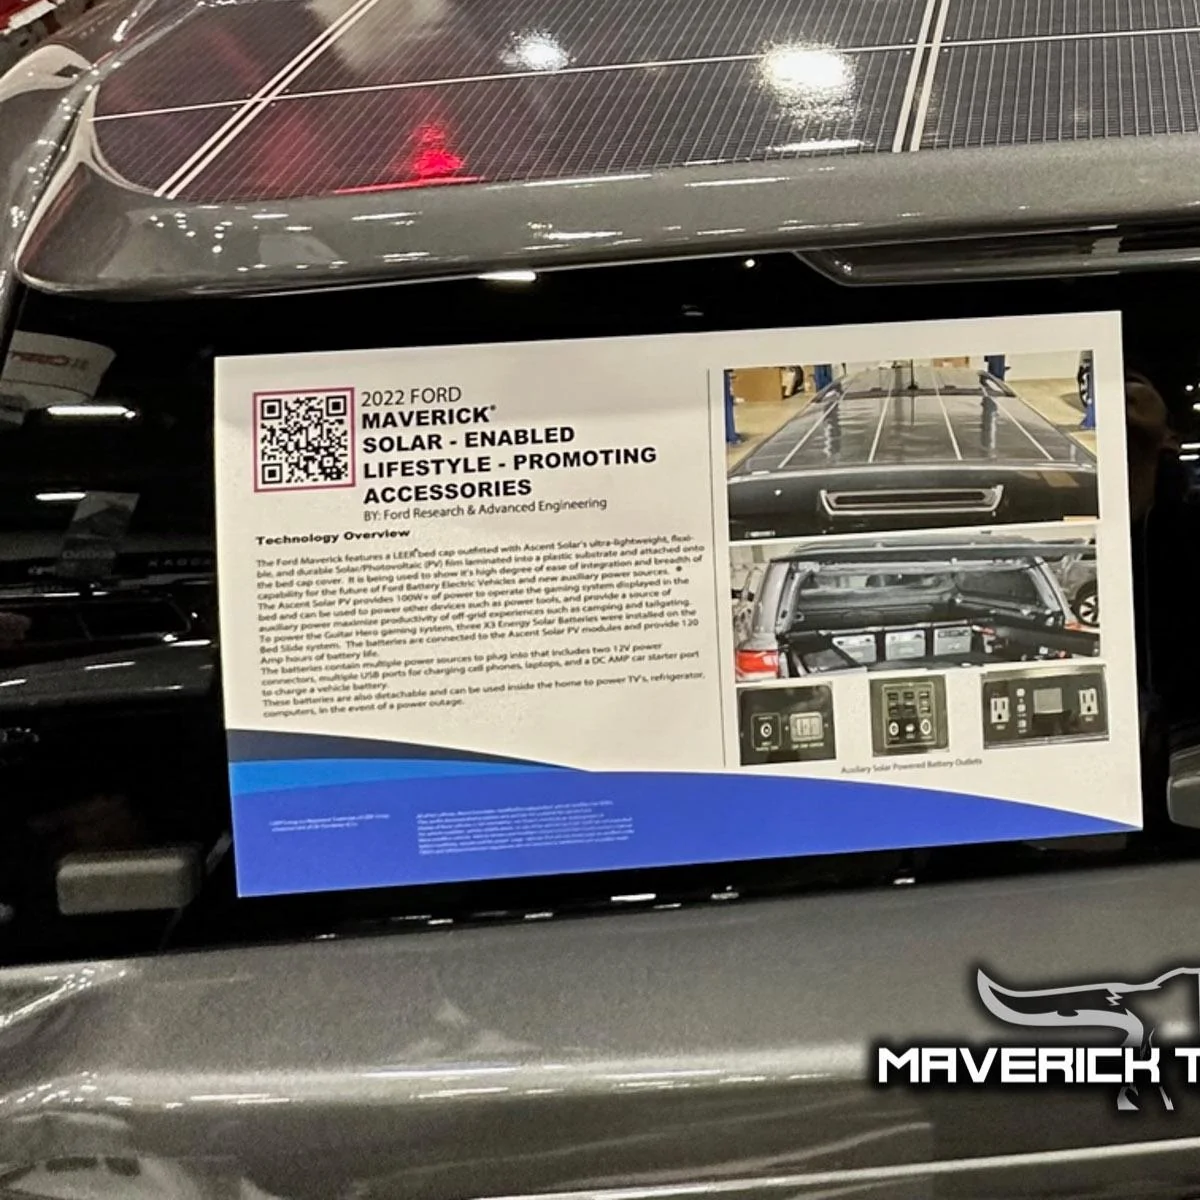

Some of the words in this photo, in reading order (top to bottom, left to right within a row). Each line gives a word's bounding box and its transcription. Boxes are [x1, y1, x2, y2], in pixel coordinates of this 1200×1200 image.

[361, 390, 405, 407] 2022
[411, 386, 462, 404] FORD
[362, 434, 443, 453] SOLAR
[464, 426, 575, 448] ENABLED
[364, 456, 492, 479] LIFESTYLE
[513, 447, 657, 470] PROMOTING
[363, 479, 532, 504] ACCESSORIES
[364, 511, 381, 522] BY:
[383, 508, 410, 521] Ford
[412, 504, 463, 519] Research
[467, 505, 476, 516] &
[478, 501, 535, 515] Advanced
[538, 498, 607, 514] Engineering
[255, 533, 339, 546] Technology
[344, 528, 410, 542] Overview
[872, 764, 891, 773] Solar
[893, 762, 926, 771] Powered
[927, 760, 954, 770] Battery
[955, 757, 982, 767] Outlets
